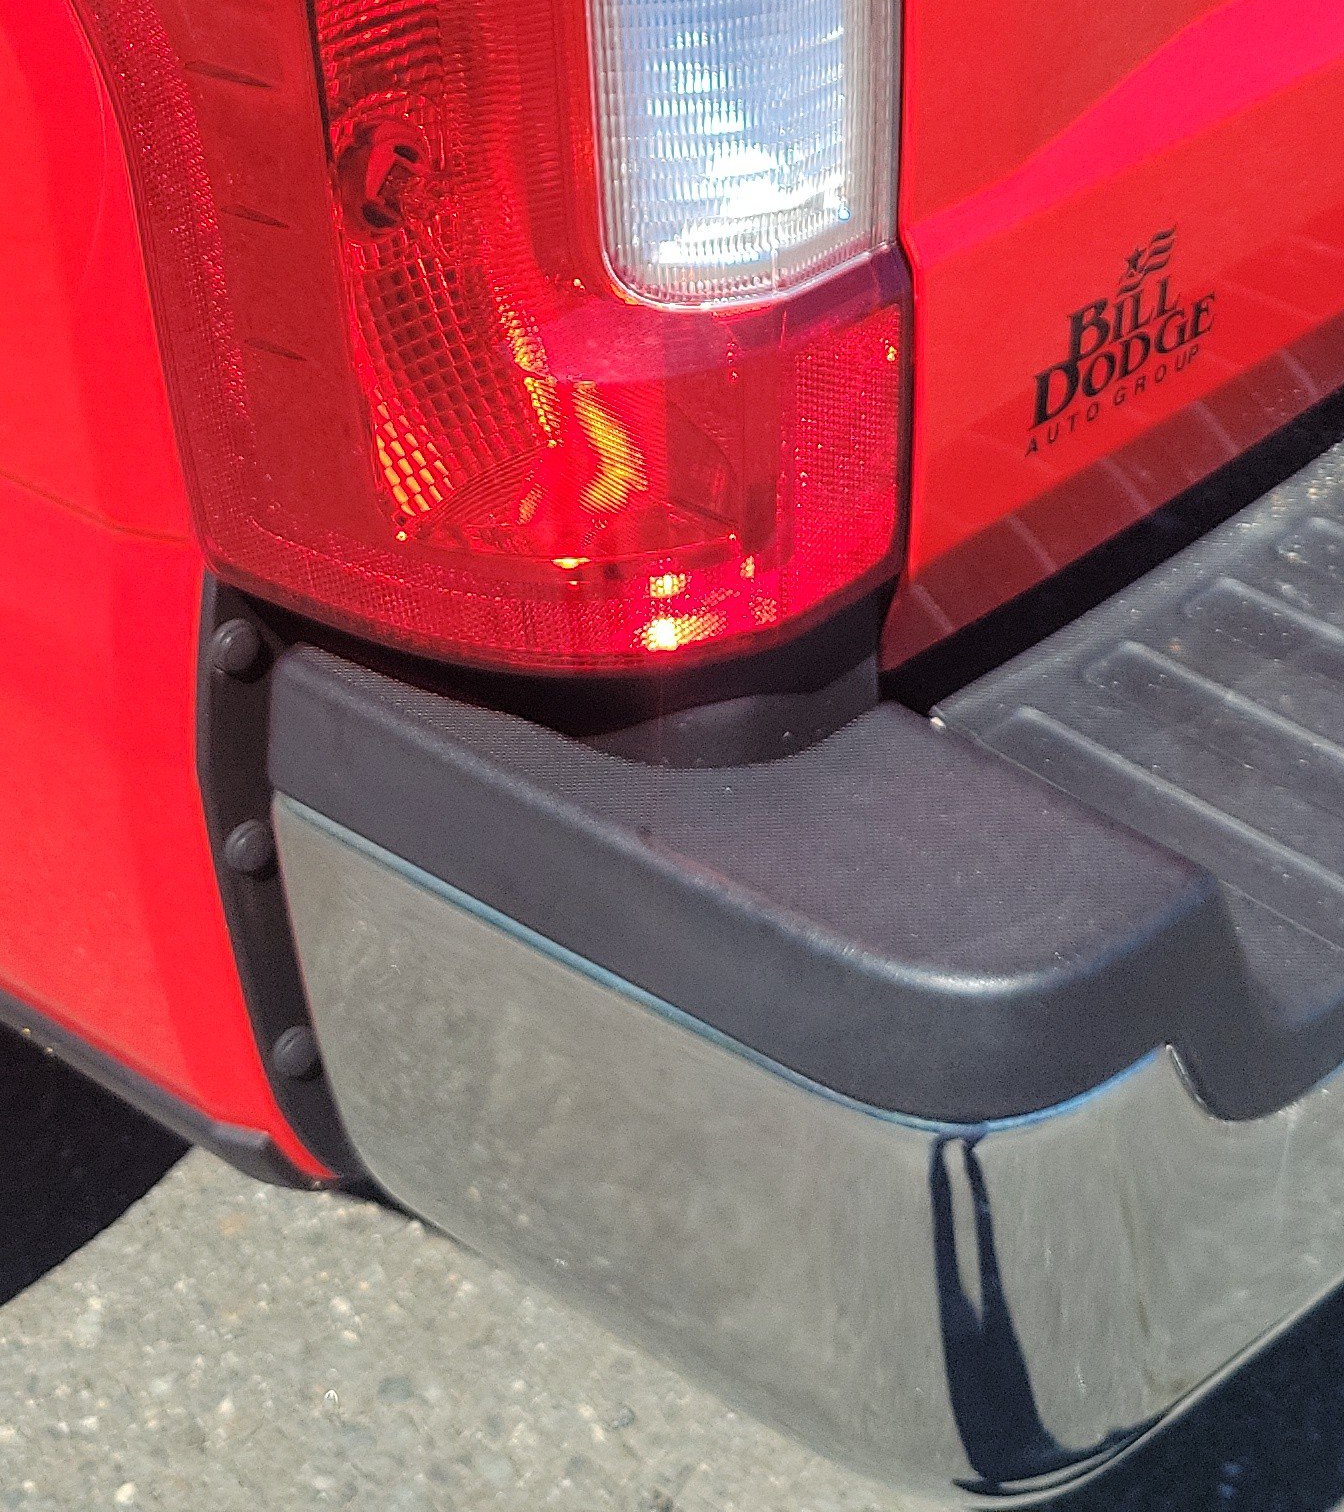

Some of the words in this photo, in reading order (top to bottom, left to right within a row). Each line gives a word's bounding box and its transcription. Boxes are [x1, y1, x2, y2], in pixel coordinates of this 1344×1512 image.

[1028, 291, 1216, 432] DODGE
[1066, 274, 1180, 363] BILL
[1024, 403, 1101, 458] AUTO
[1112, 343, 1200, 407] GROUP
